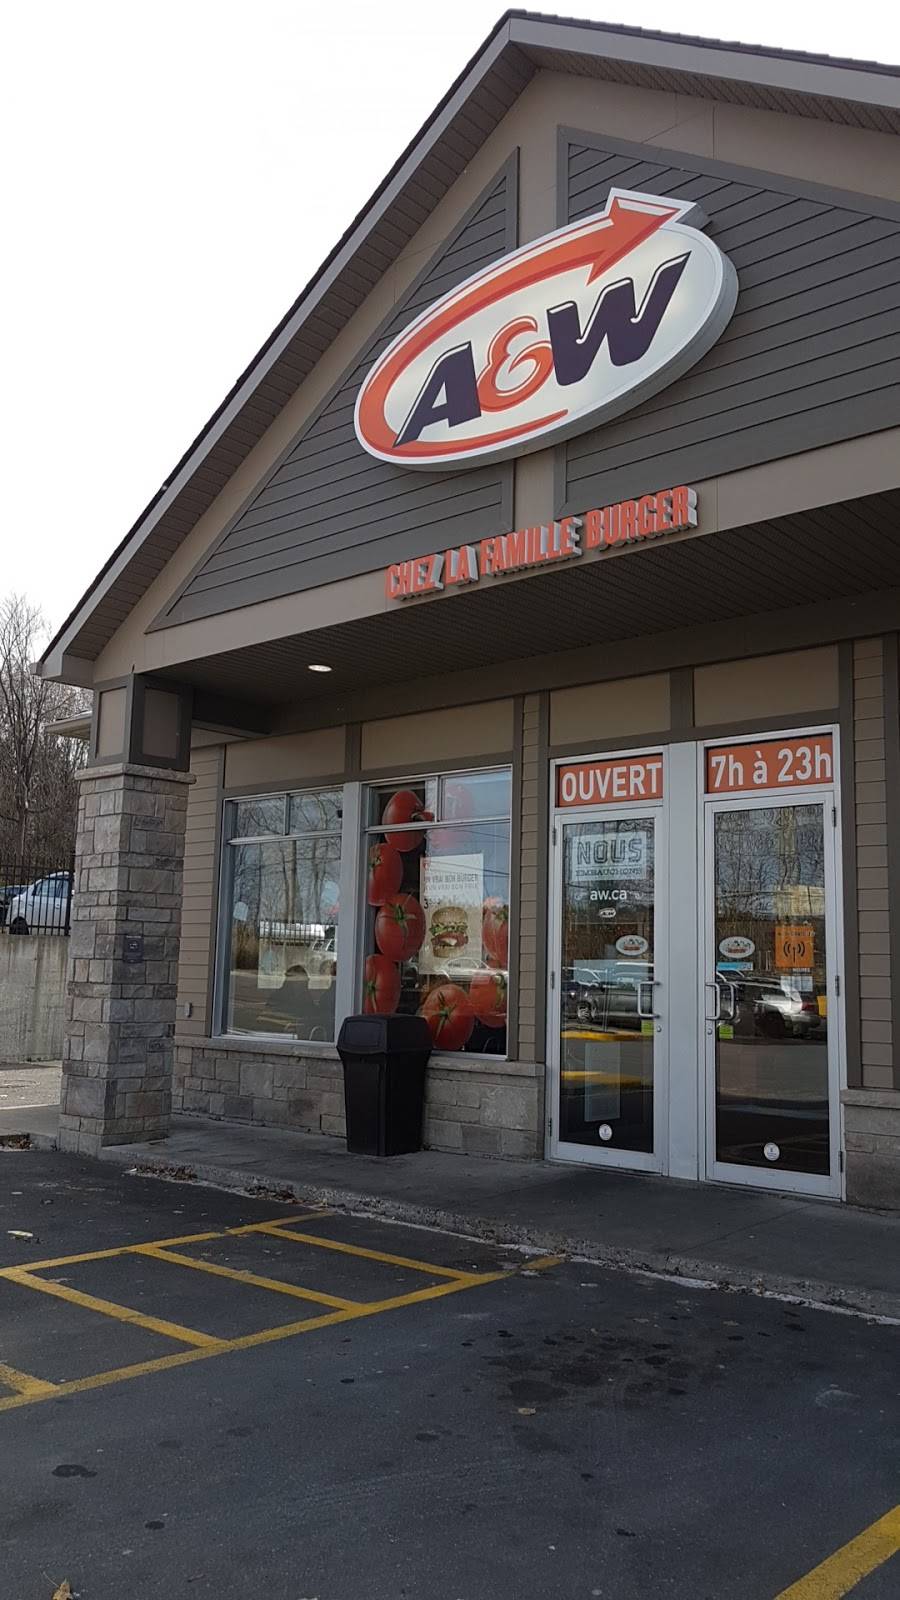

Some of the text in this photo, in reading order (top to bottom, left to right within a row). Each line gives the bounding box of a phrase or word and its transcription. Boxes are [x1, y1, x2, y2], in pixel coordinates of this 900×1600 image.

[392, 250, 692, 448] A&W
[385, 486, 697, 600] CHEZ LA FAMILLE BURGER
[561, 762, 662, 802] OUVERT
[711, 745, 832, 788] 7h à 23h
[577, 838, 642, 865] NOUS
[590, 889, 627, 901] aw.ca
